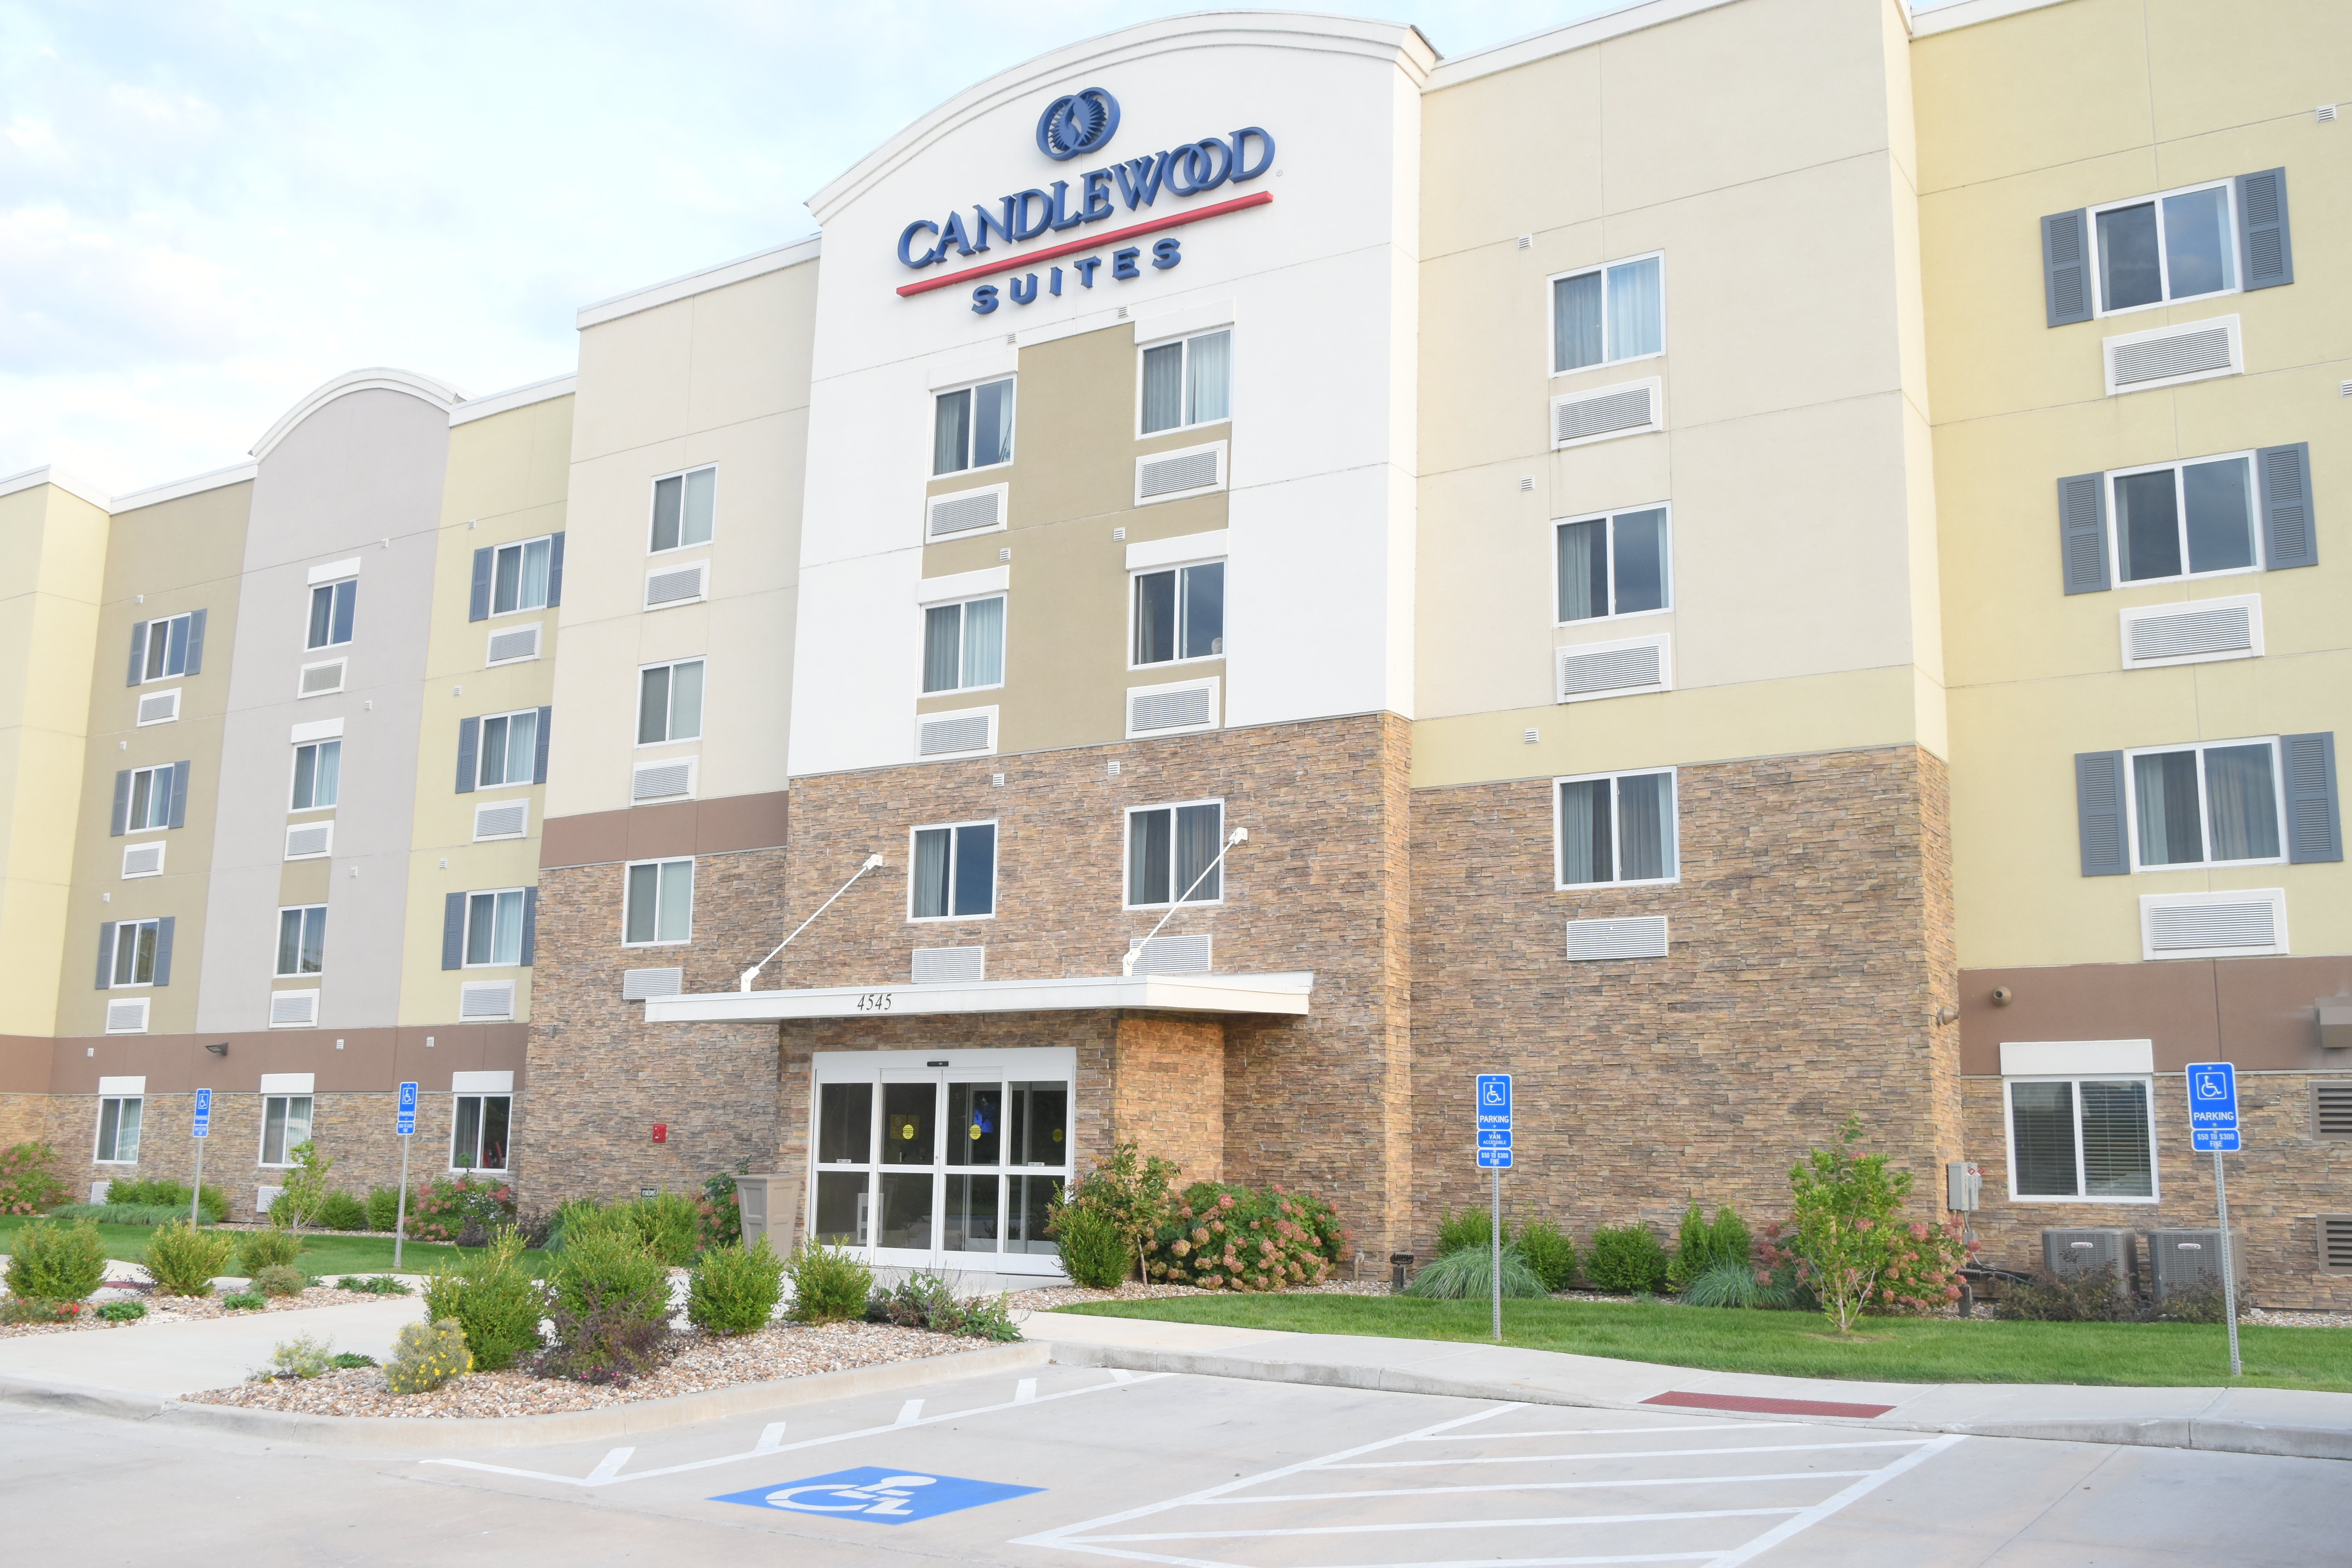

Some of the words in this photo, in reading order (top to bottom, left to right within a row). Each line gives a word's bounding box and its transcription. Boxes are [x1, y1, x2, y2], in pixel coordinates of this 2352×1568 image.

[897, 126, 1275, 269] CANDLEWOOD
[971, 238, 1181, 314] SUITES
[857, 994, 891, 1010] 4545
[2194, 1112, 2234, 1121] PARKING
